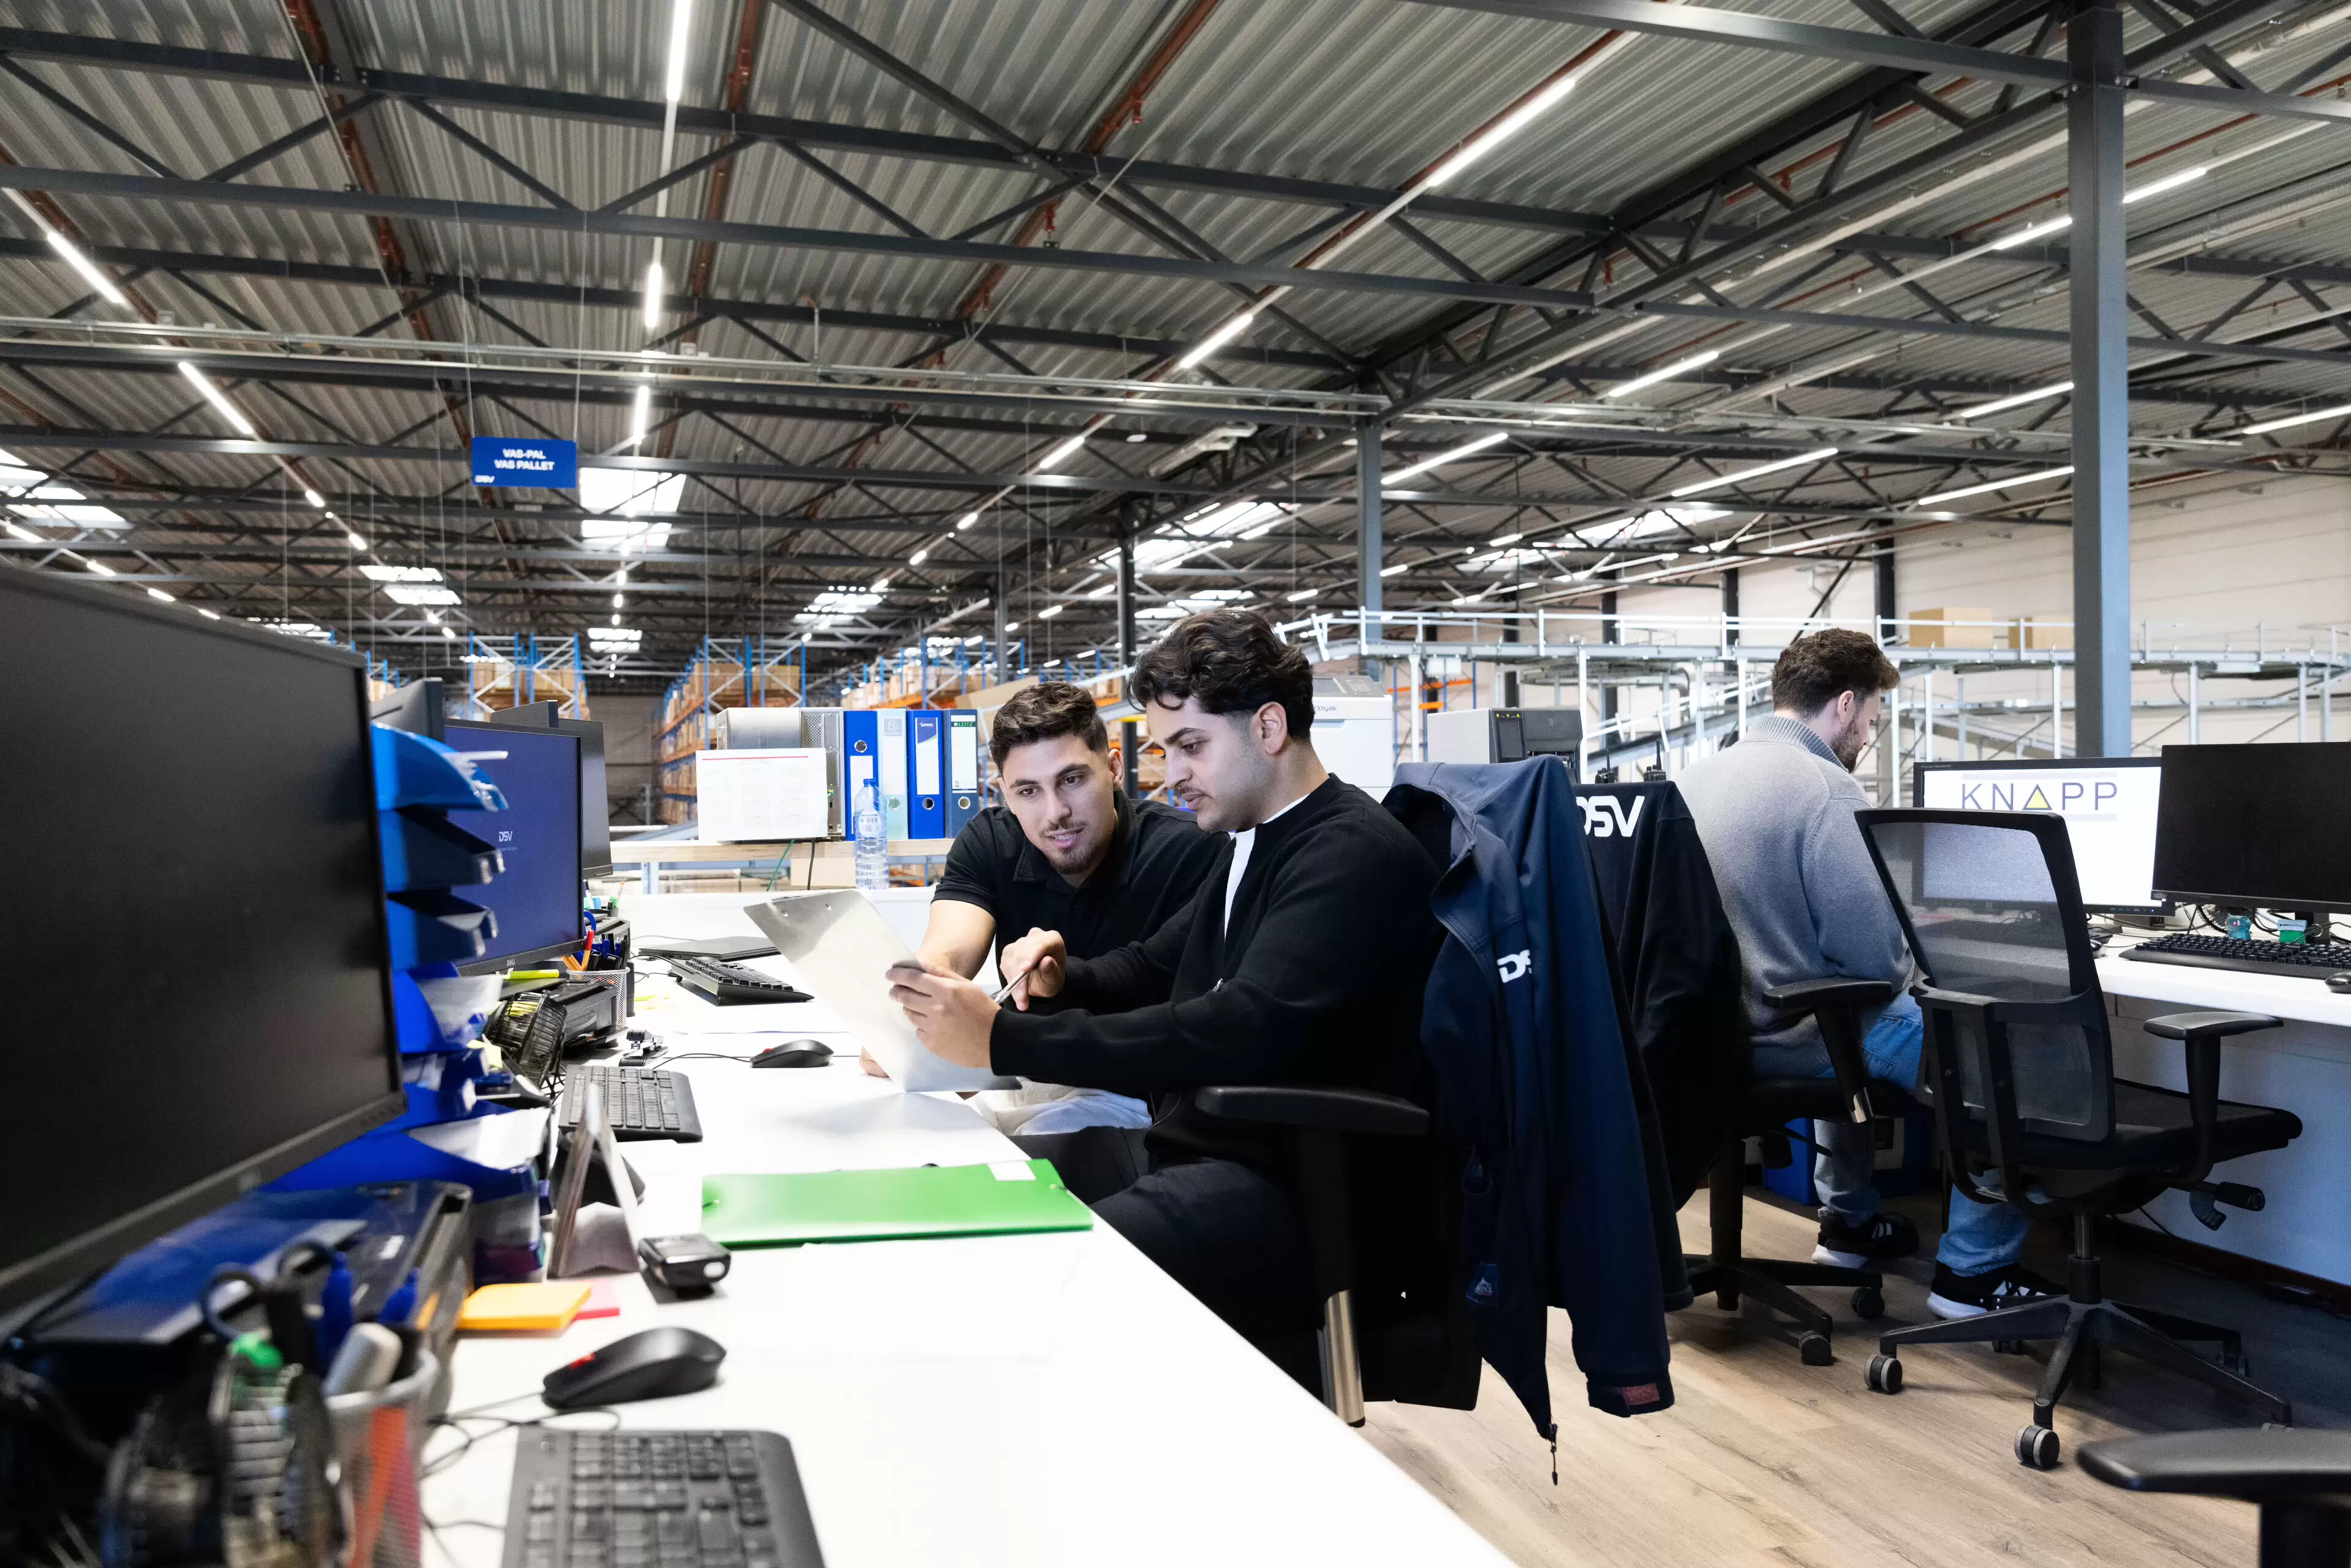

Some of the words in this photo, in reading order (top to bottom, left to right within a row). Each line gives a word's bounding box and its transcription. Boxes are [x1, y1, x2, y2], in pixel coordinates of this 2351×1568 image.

[502, 448, 546, 460] VAS-PAL
[494, 459, 516, 470] VAS
[516, 460, 555, 471] PALLET
[1962, 781, 2118, 811] KNAPP
[499, 831, 513, 842] DSV
